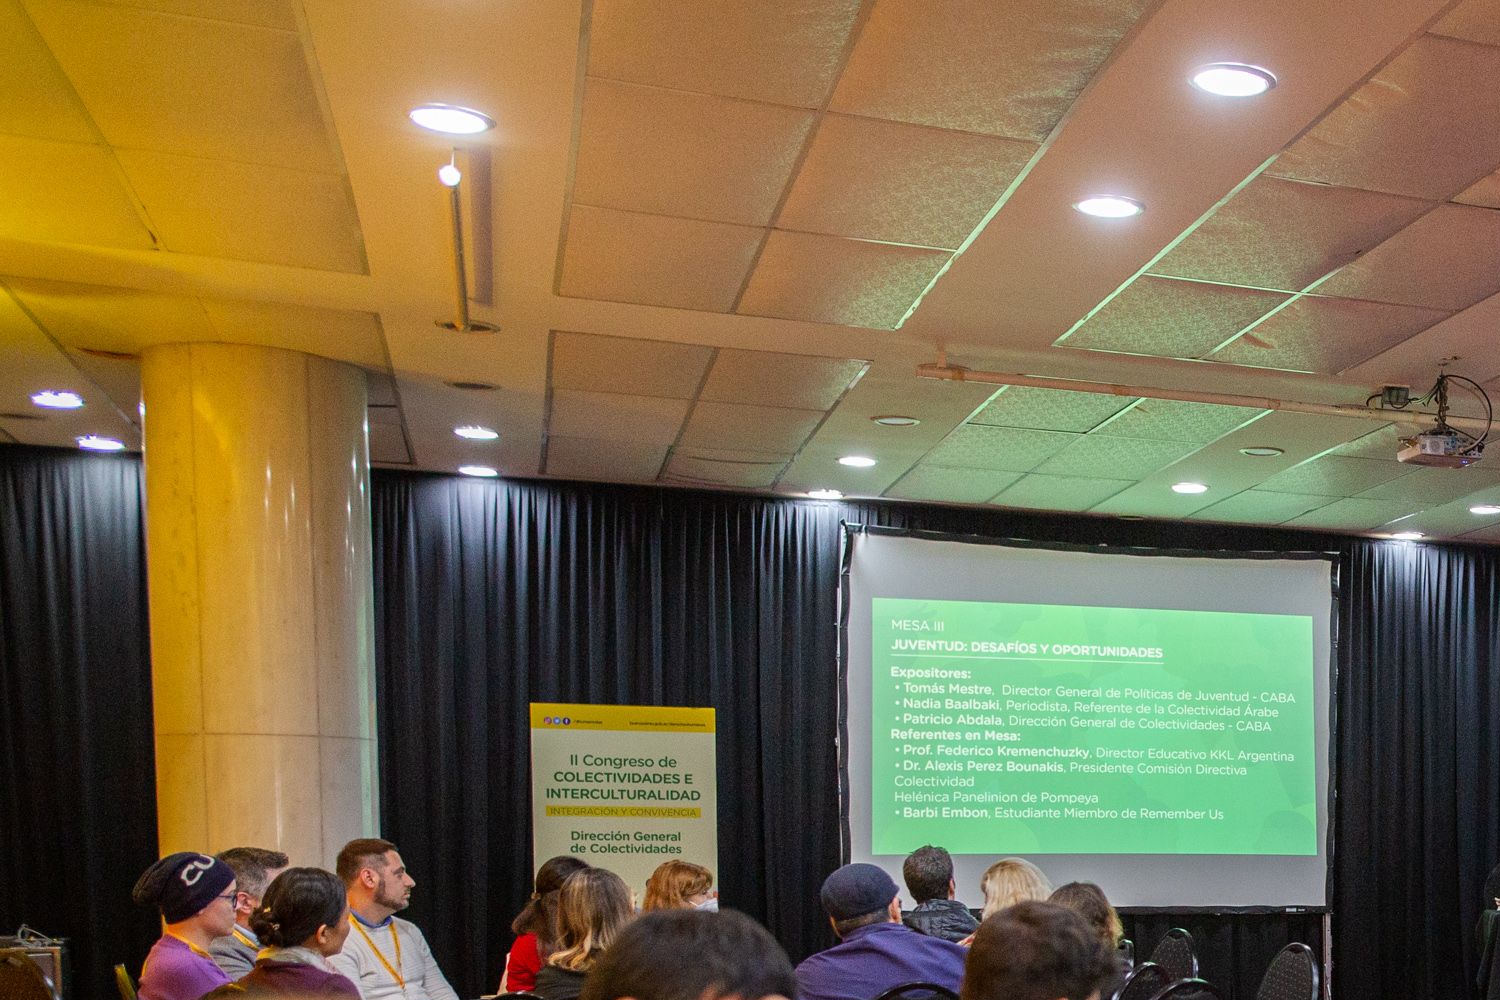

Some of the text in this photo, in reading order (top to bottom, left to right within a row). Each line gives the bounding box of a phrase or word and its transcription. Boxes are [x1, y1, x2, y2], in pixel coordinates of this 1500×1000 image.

[891, 620, 944, 631] MESA III
[891, 639, 1163, 658] JUVENTUD: DESAFÍOS Y OPORTUNIDADES
[890, 666, 971, 680] Expositores:
[903, 682, 945, 694] Tomás
[949, 684, 995, 696] Mestre,
[1002, 685, 1052, 697] Director
[1055, 686, 1101, 698] General
[1105, 688, 1121, 699] de
[1124, 688, 1174, 700] Políticas
[1177, 689, 1192, 700] de
[1195, 691, 1249, 702] Juventud
[1260, 692, 1296, 703] CABA
[903, 698, 1279, 717] Nadia Baalbaki, Periodista, Referente de la Colectividad Árabe
[903, 713, 953, 725] Patricio
[956, 714, 1005, 726] Abdala,
[1009, 715, 1066, 727] Dirección
[1070, 716, 1116, 728] General
[1120, 718, 1135, 728] de
[1138, 718, 1225, 730] Colectividades
[1236, 720, 1272, 732] CABA
[890, 728, 1021, 741] Referentes en Mesa:
[903, 744, 1295, 763] Prof. Federico Kremenchuzky, Director Educativo KKL Argentina
[570, 754, 677, 769] II Congreso de
[903, 760, 1247, 775] Dr. Alexis Perez Bounakis, Presidente Comisión Directiva
[553, 771, 693, 785] COLECTIVIDADES E
[894, 775, 975, 787] Colectividad
[546, 788, 701, 801] INTERCULTURALIDAD
[894, 791, 1099, 805] Helénica Panelinion de Pompeya
[550, 807, 697, 817] INTEGRACIÓN Y CONVIVENCIA
[903, 807, 1224, 820] Barbi Embon, Estudiante Miembro de Remember Us
[571, 831, 681, 842] Dirección General
[570, 843, 682, 854] de Colectividades
